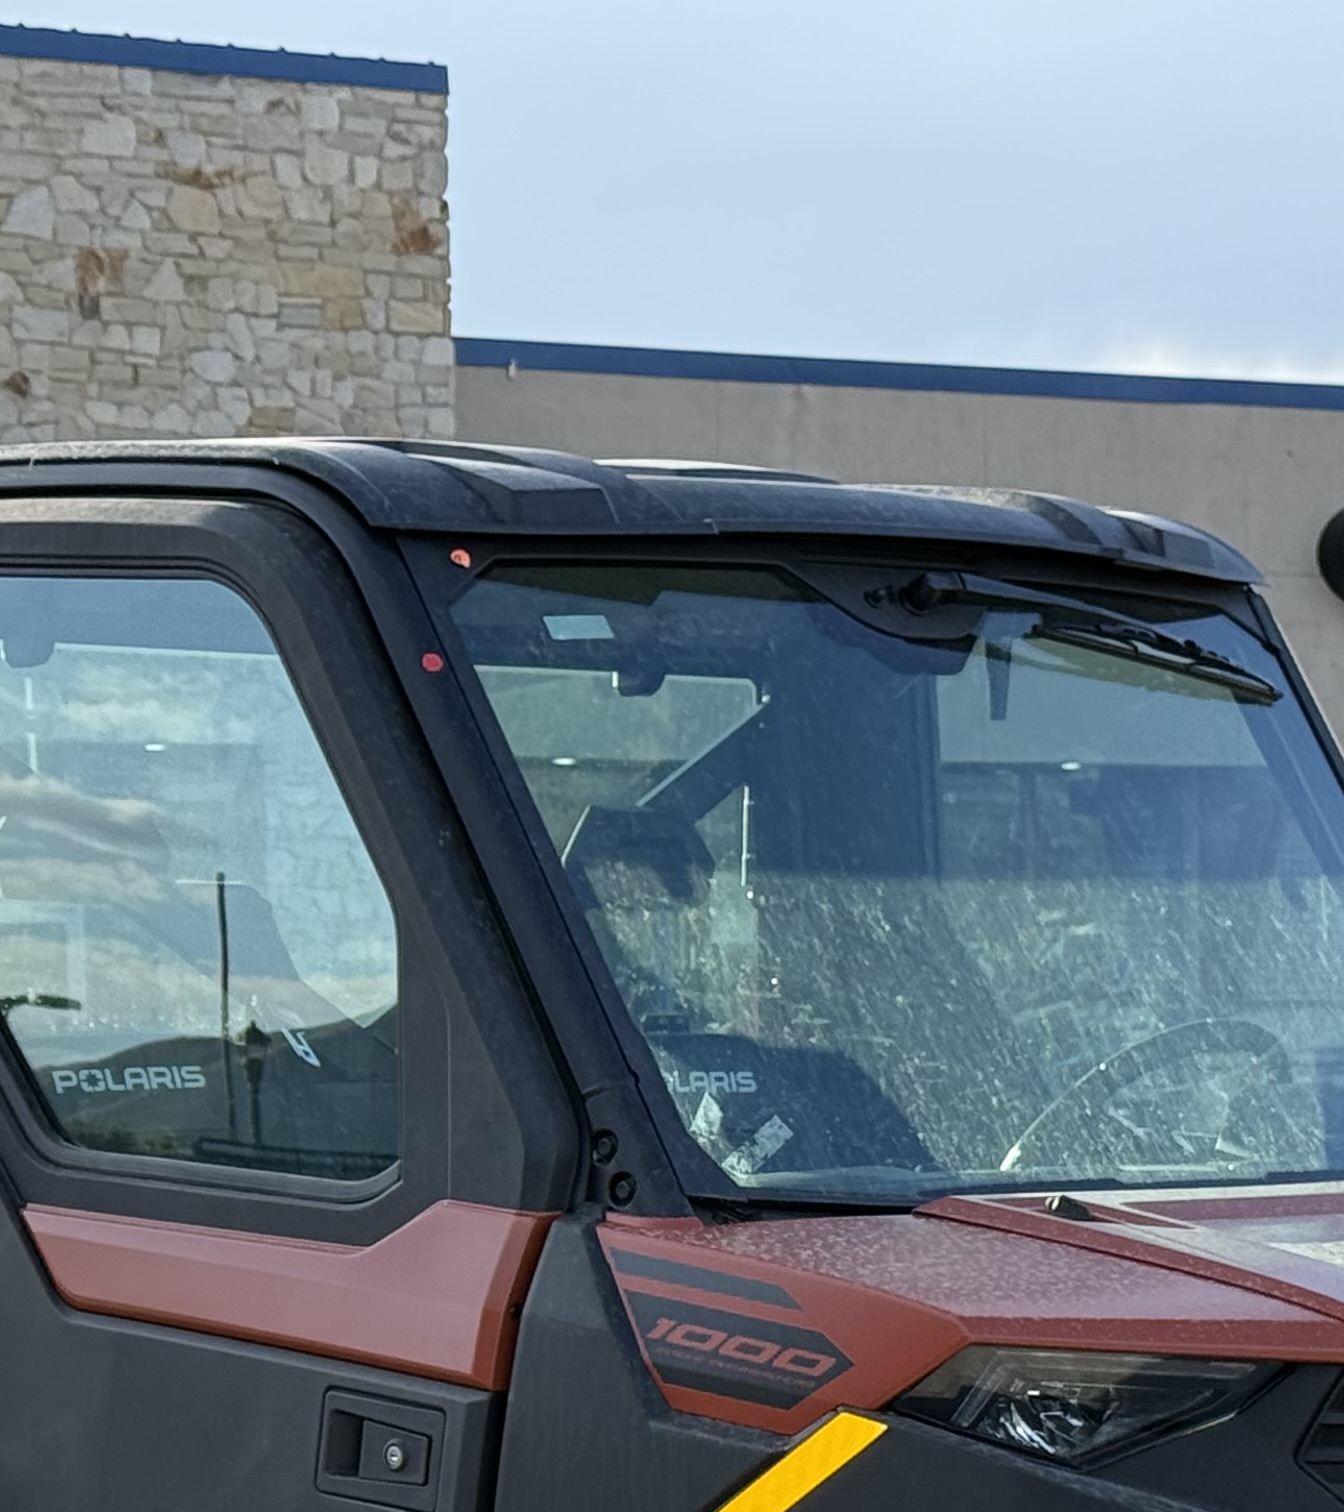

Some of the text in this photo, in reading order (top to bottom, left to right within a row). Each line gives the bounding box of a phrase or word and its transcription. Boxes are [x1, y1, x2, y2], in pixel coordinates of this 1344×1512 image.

[52, 1065, 206, 1094] POLARIS
[669, 1070, 757, 1094] LARIS
[645, 1316, 836, 1377] 1000
